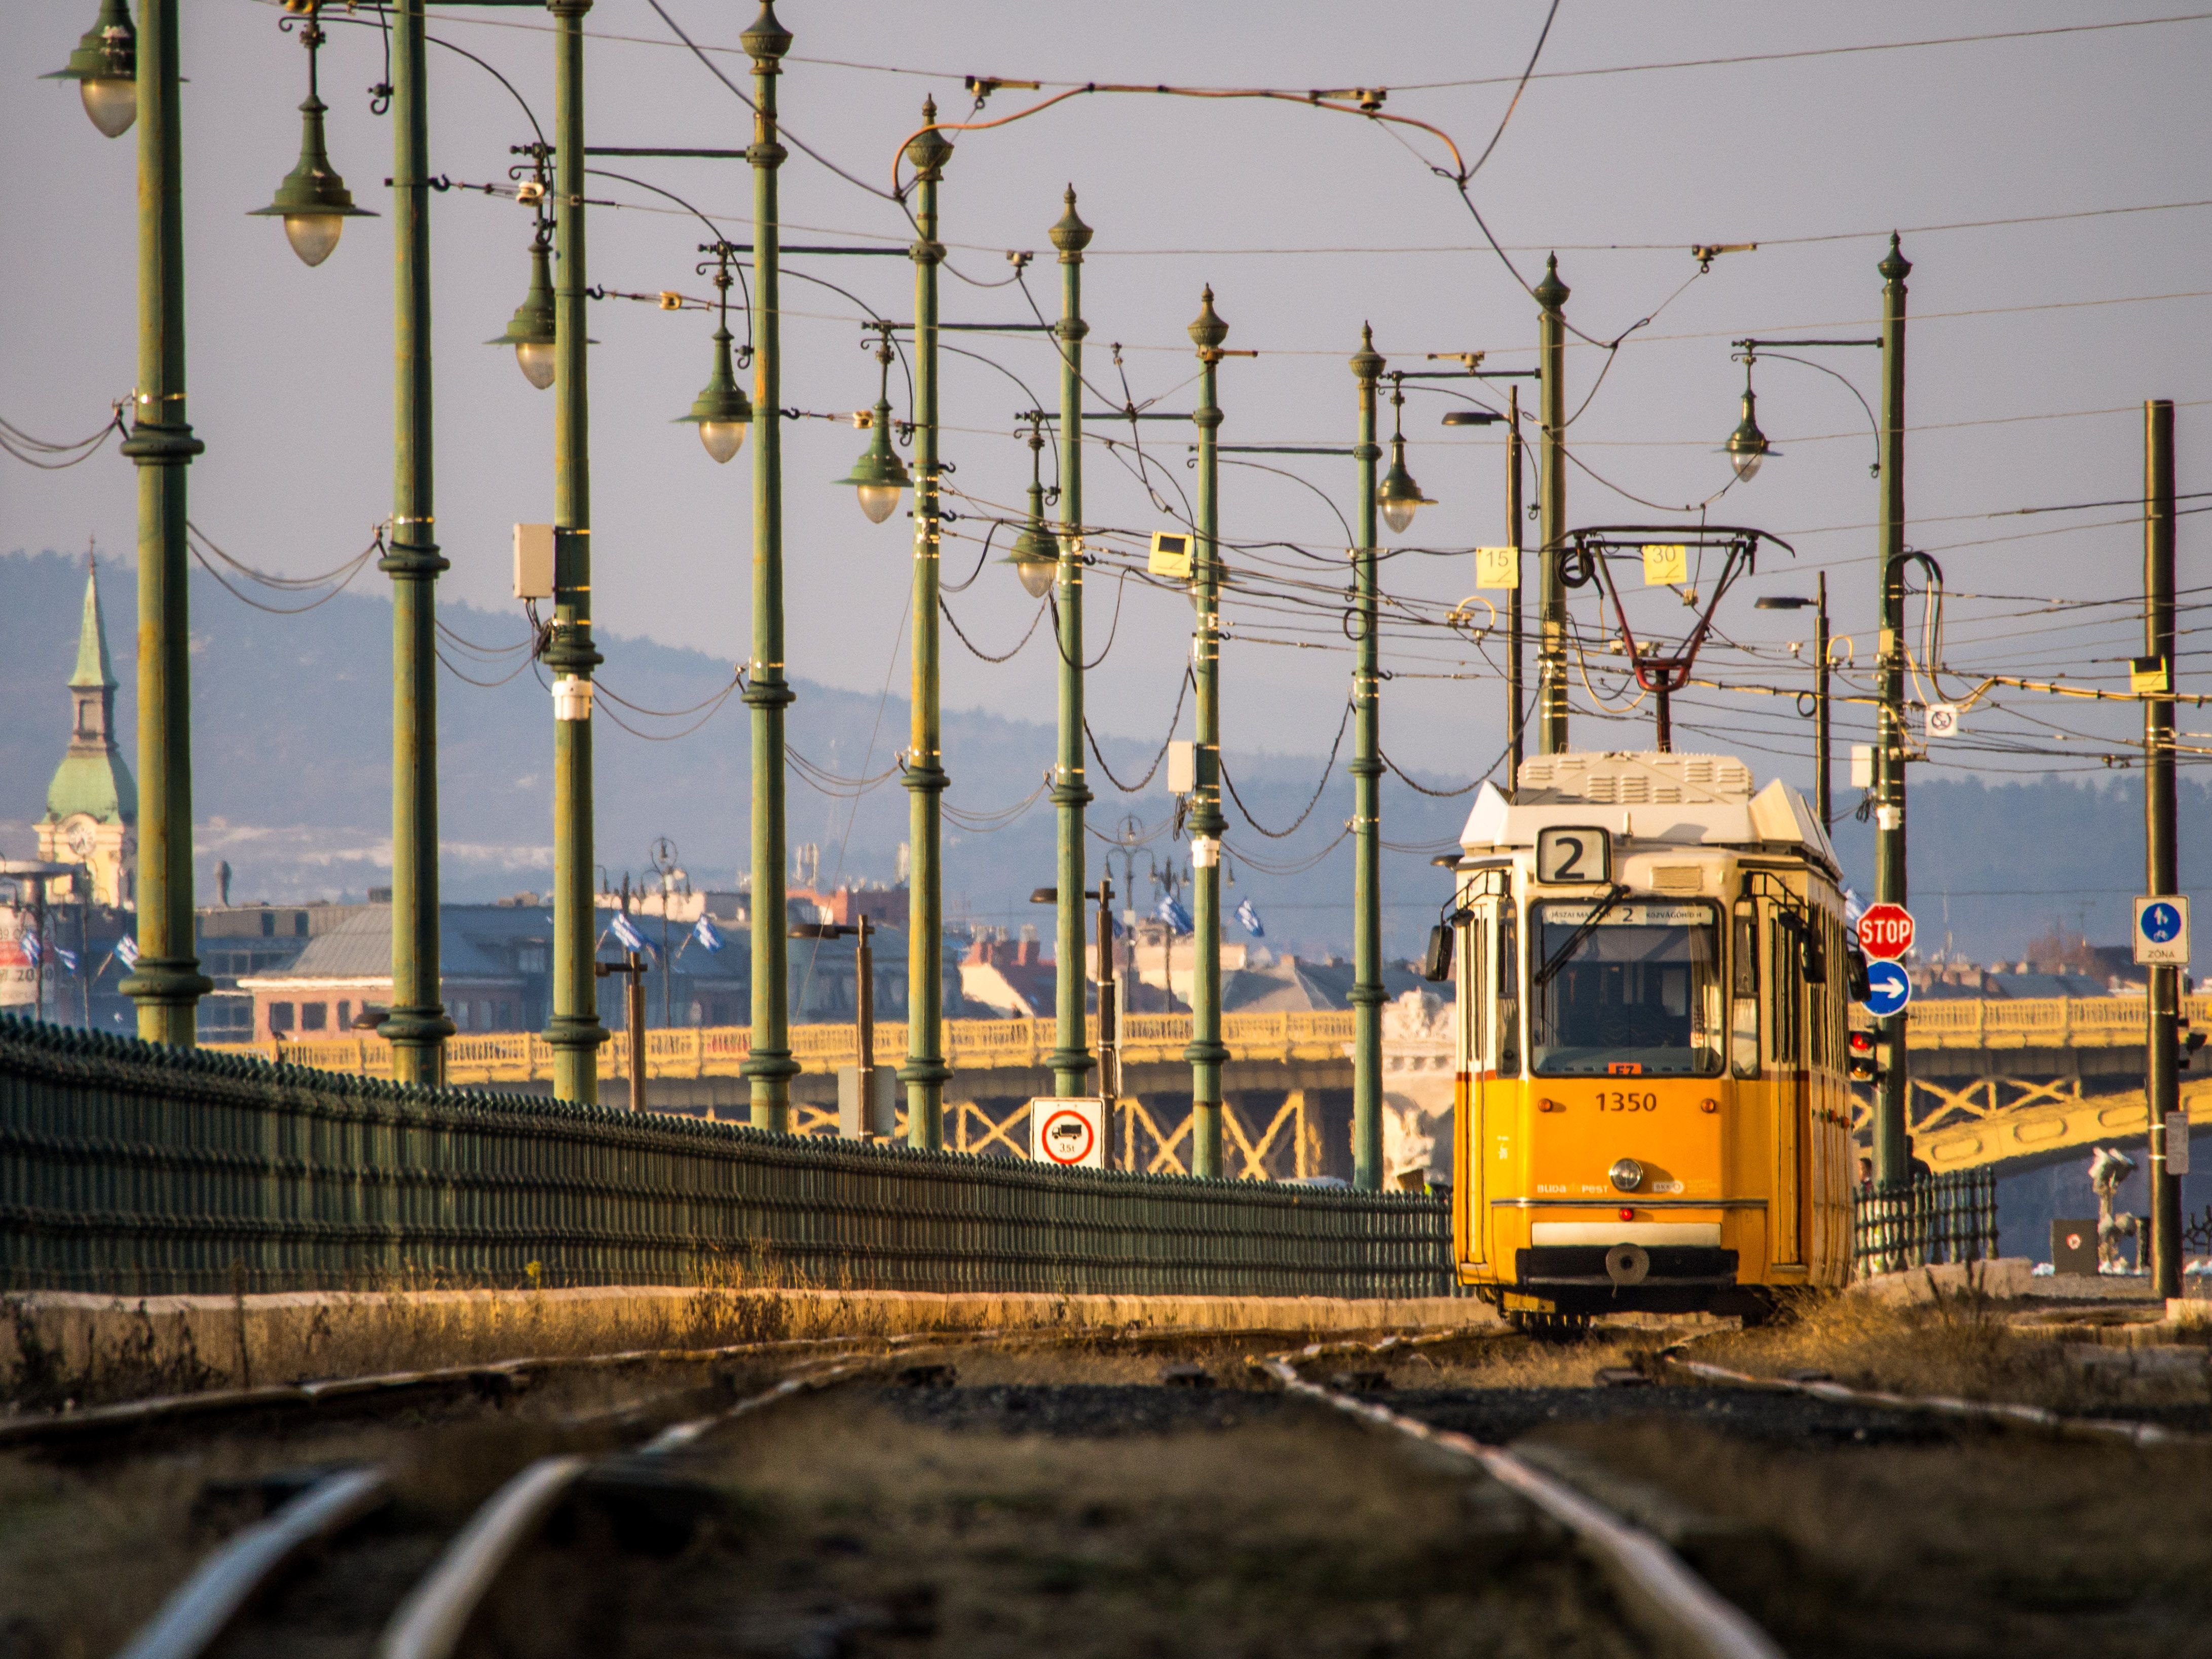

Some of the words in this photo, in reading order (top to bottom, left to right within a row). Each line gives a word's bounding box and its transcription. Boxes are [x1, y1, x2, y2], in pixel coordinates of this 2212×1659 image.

[1486, 550, 1509, 567] 15
[1653, 545, 1676, 563] 30
[1555, 837, 1585, 879] 2
[1623, 908, 1633, 922] 2
[1861, 920, 1910, 944] STOP
[1596, 1092, 1657, 1111] 1350
